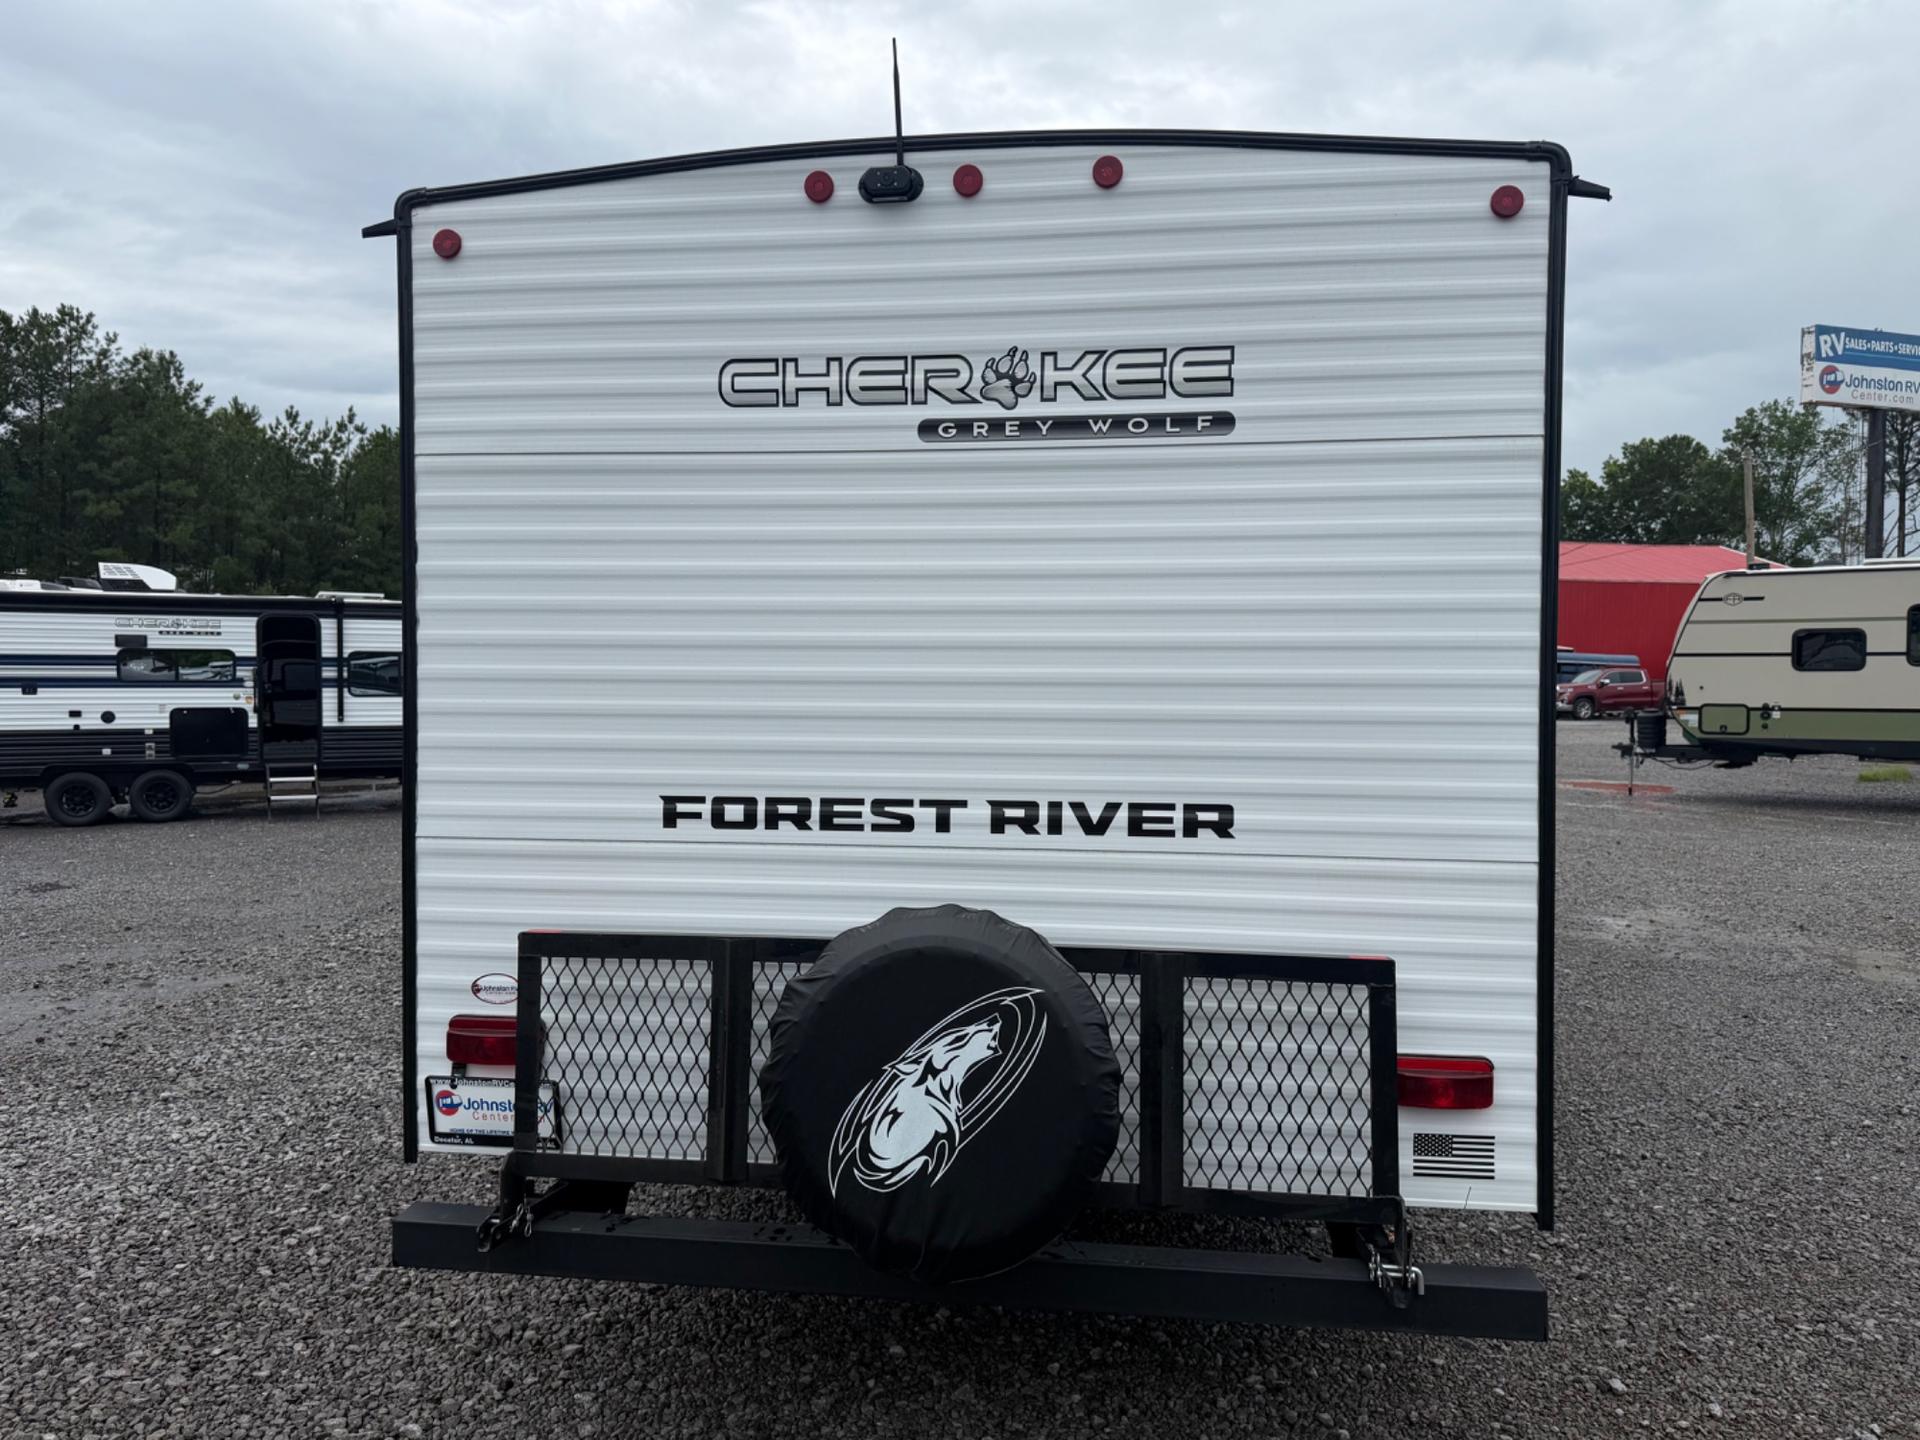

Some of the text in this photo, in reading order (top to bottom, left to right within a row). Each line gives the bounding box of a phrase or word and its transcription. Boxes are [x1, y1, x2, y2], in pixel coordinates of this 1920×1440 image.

[1819, 332, 1845, 358] RV
[1845, 374, 1920, 394] Johnston RV
[1851, 389, 1914, 404] Center.com
[937, 415, 1213, 437] GREY WOLF
[659, 795, 1236, 840] FOREST RIVER
